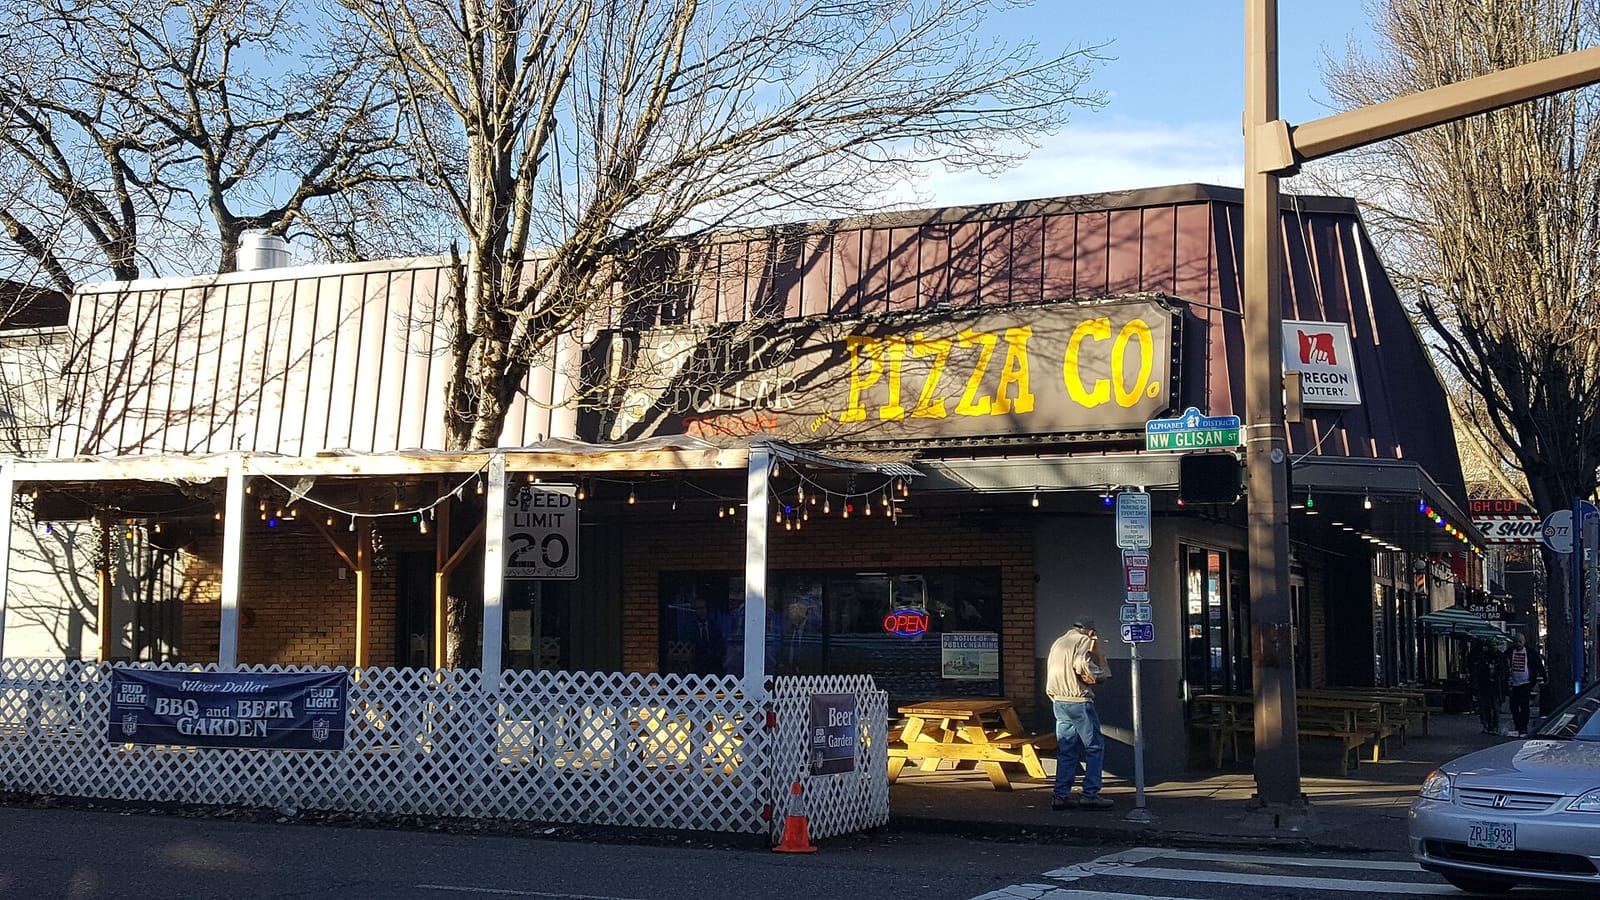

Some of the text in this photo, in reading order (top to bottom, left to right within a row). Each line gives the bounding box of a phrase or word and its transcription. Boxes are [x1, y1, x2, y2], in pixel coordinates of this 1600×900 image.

[838, 317, 1159, 423] PIZZA CO.
[1303, 372, 1348, 384] REGON
[668, 377, 797, 414] DOLLAR
[1149, 422, 1184, 430] ALPHABET
[1203, 419, 1236, 427] DISTRICT
[1151, 430, 1237, 448] NW GLISAN ST
[507, 492, 571, 511] SPEED
[1469, 500, 1520, 512] IGH CUT
[514, 513, 565, 528] LIMIT
[1496, 521, 1543, 537] SHOP
[1556, 526, 1569, 535] 77
[508, 533, 570, 569] 20
[884, 615, 929, 632] OPEN
[122, 684, 143, 693] BUD
[180, 680, 268, 694] Silver Dollar
[311, 688, 334, 698] BUD
[117, 693, 146, 704] LIGHT
[306, 698, 338, 708] LIGHT
[154, 698, 295, 719] BBQ and BEER
[828, 707, 853, 727] Beer
[177, 717, 267, 737] GARDEN
[828, 734, 853, 748] Garden
[1470, 825, 1512, 843] ZRJ 938
